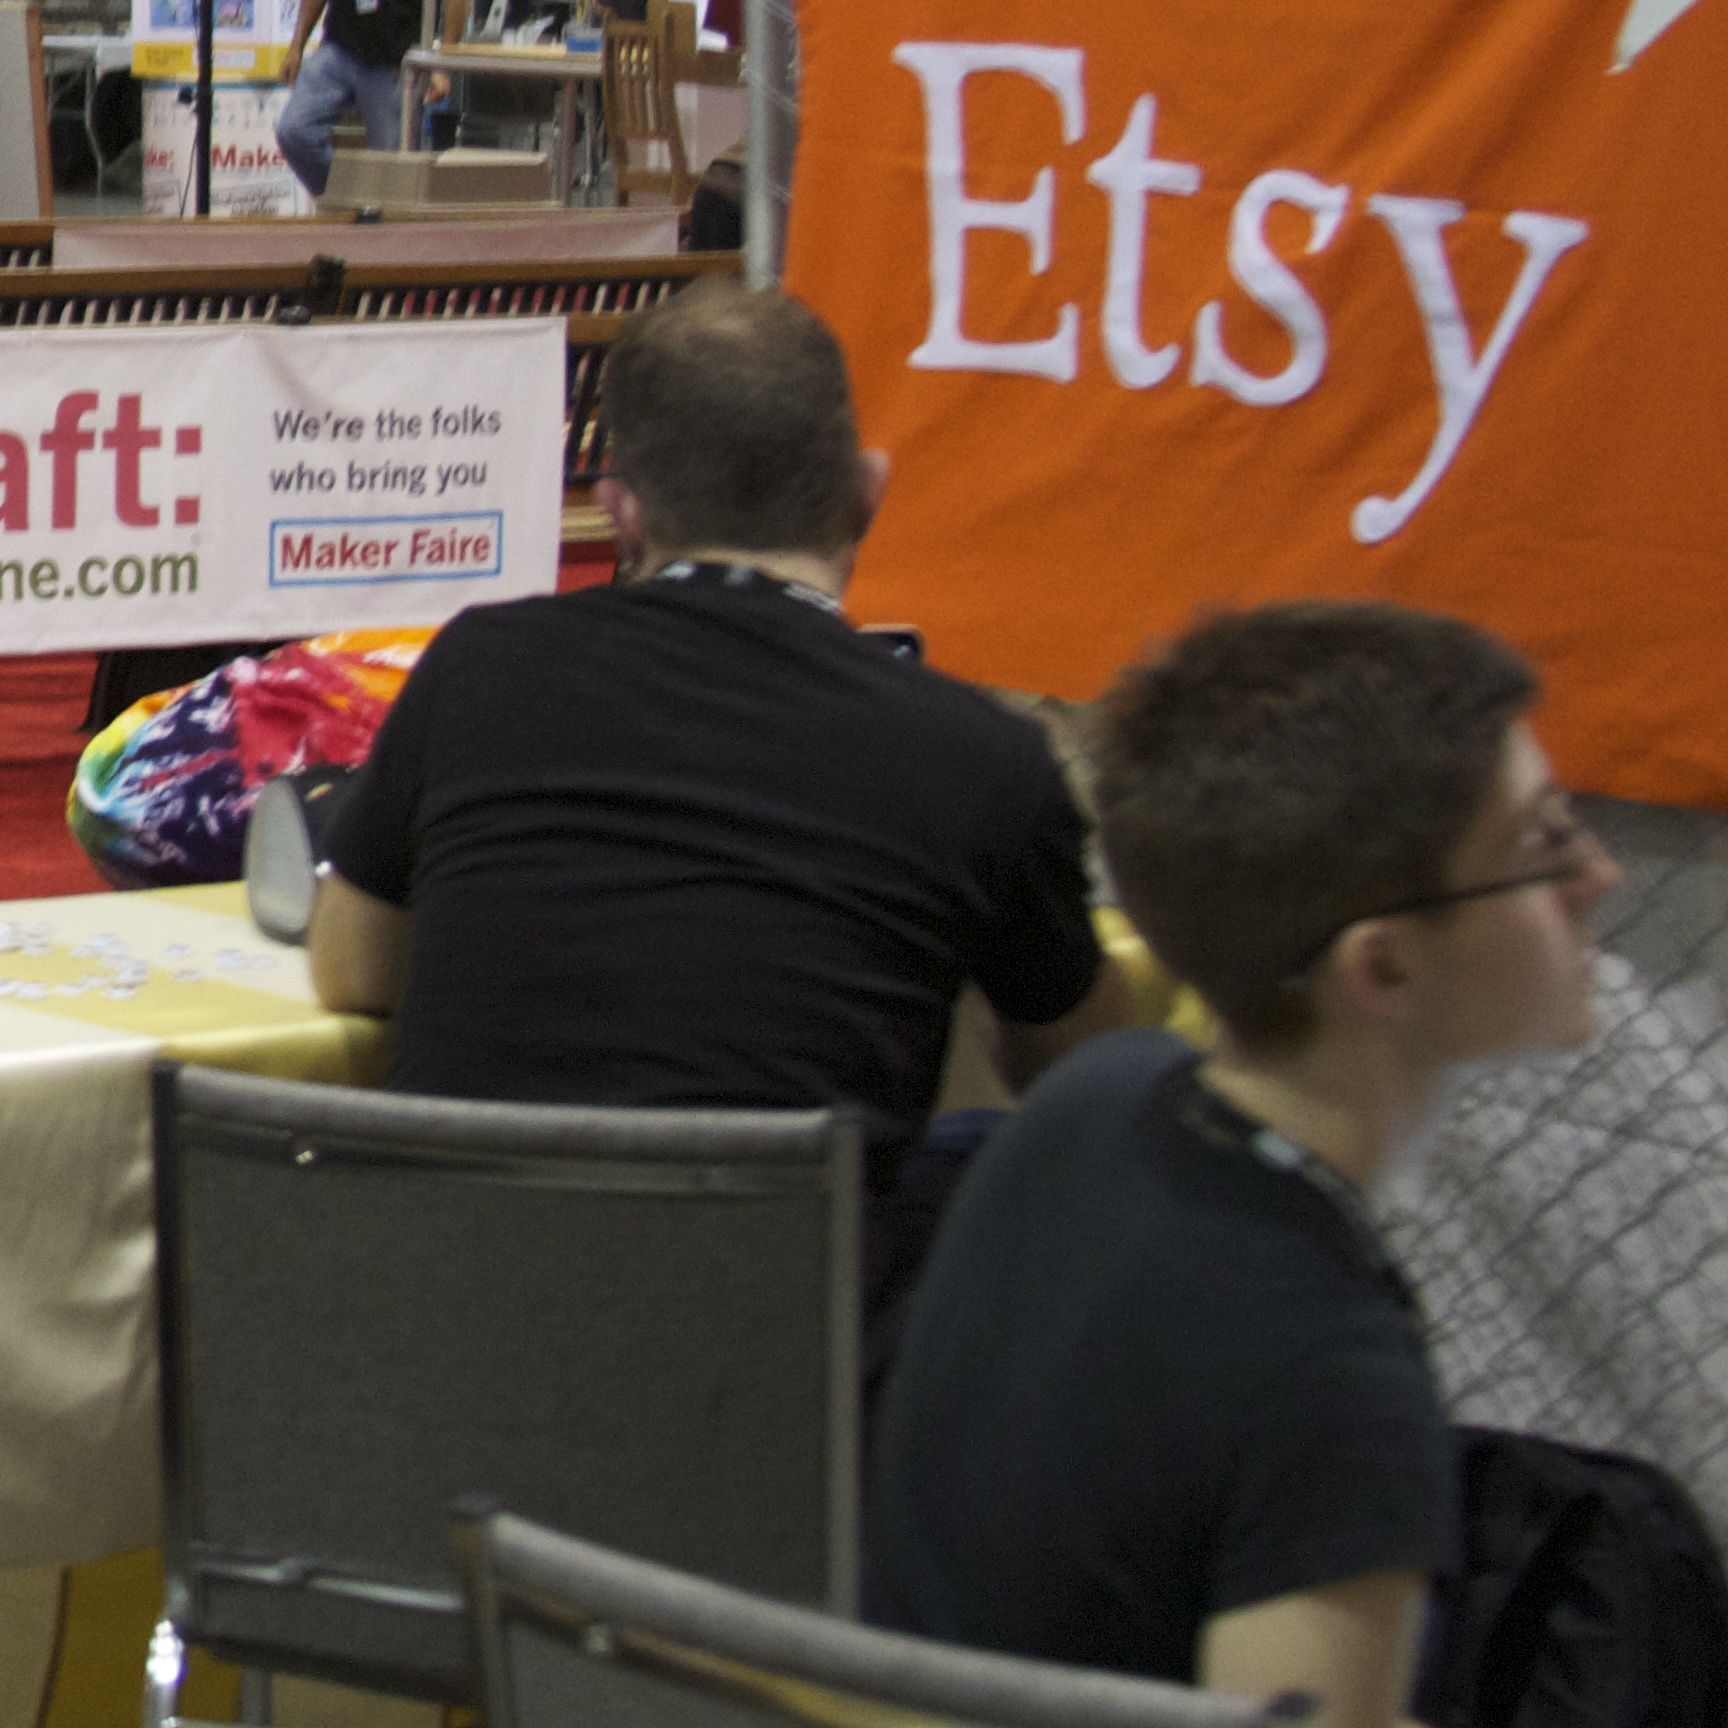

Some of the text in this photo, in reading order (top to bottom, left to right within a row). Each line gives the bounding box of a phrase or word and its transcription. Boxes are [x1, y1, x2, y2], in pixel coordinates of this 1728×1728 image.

[891, 38, 1590, 544] Etsy
[273, 403, 503, 442] We're the folks
[270, 459, 489, 498] who bring you
[280, 524, 493, 572] Maker Faire
